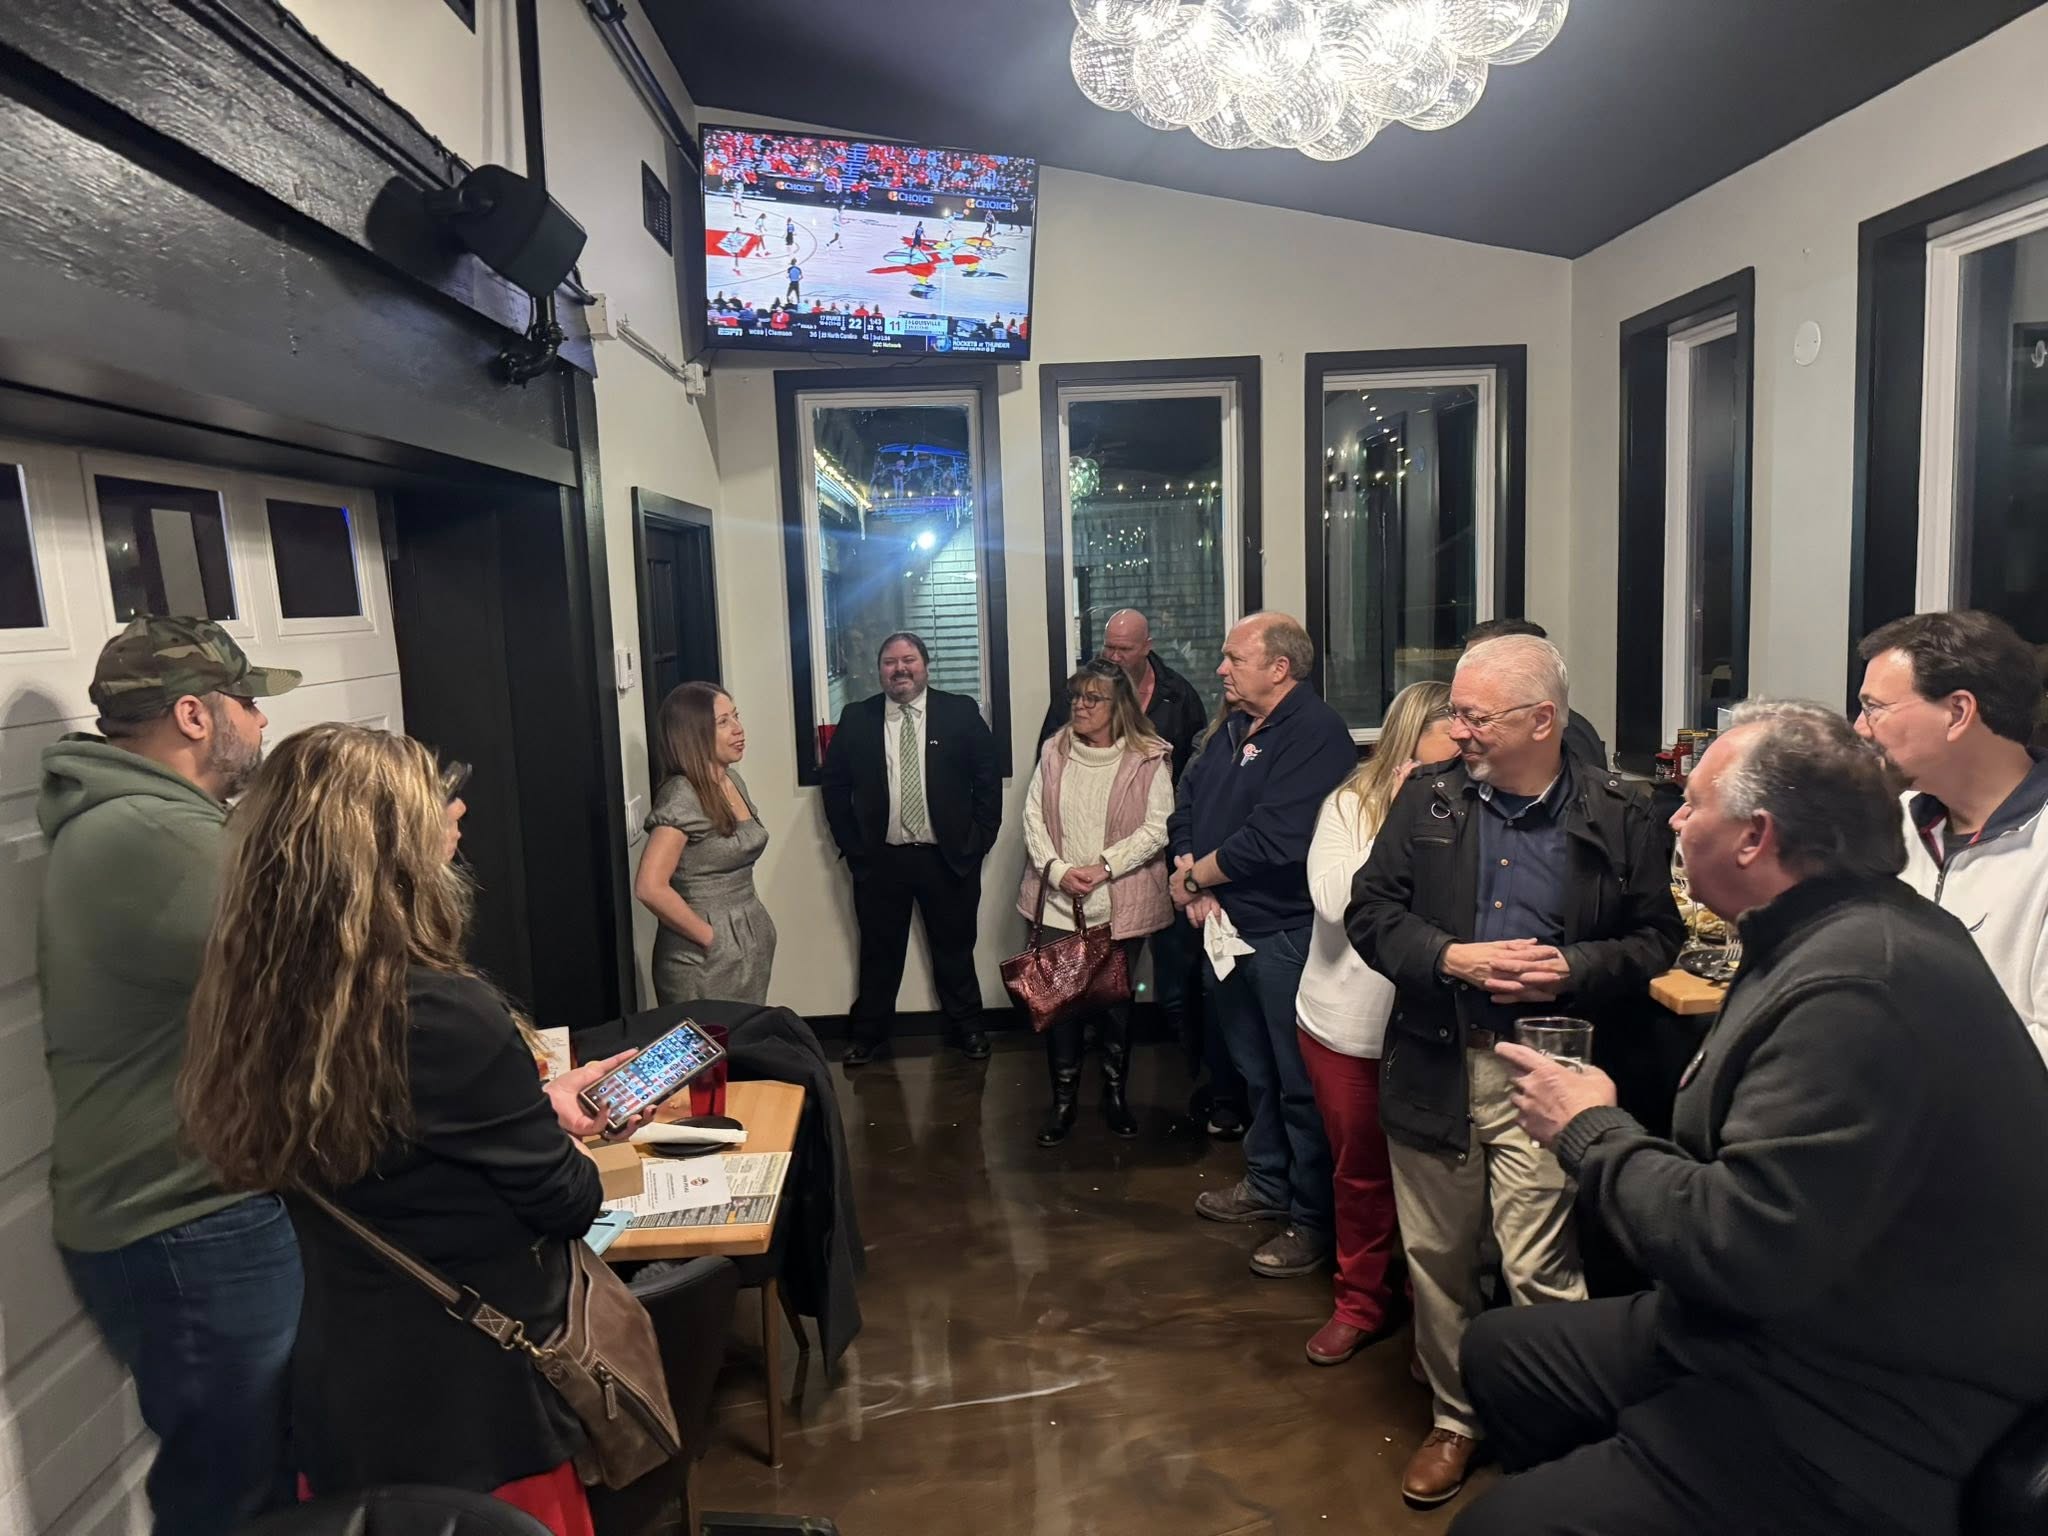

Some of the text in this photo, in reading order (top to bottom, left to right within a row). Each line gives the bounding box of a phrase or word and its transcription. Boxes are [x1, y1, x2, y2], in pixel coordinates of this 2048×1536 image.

[784, 182, 815, 193] CHOICE
[898, 192, 934, 204] CHOICE
[975, 199, 1012, 211] CHOICE
[848, 318, 862, 330] 22
[889, 320, 901, 332] 11
[717, 327, 743, 337] ESPN
[768, 329, 793, 337] Clemson
